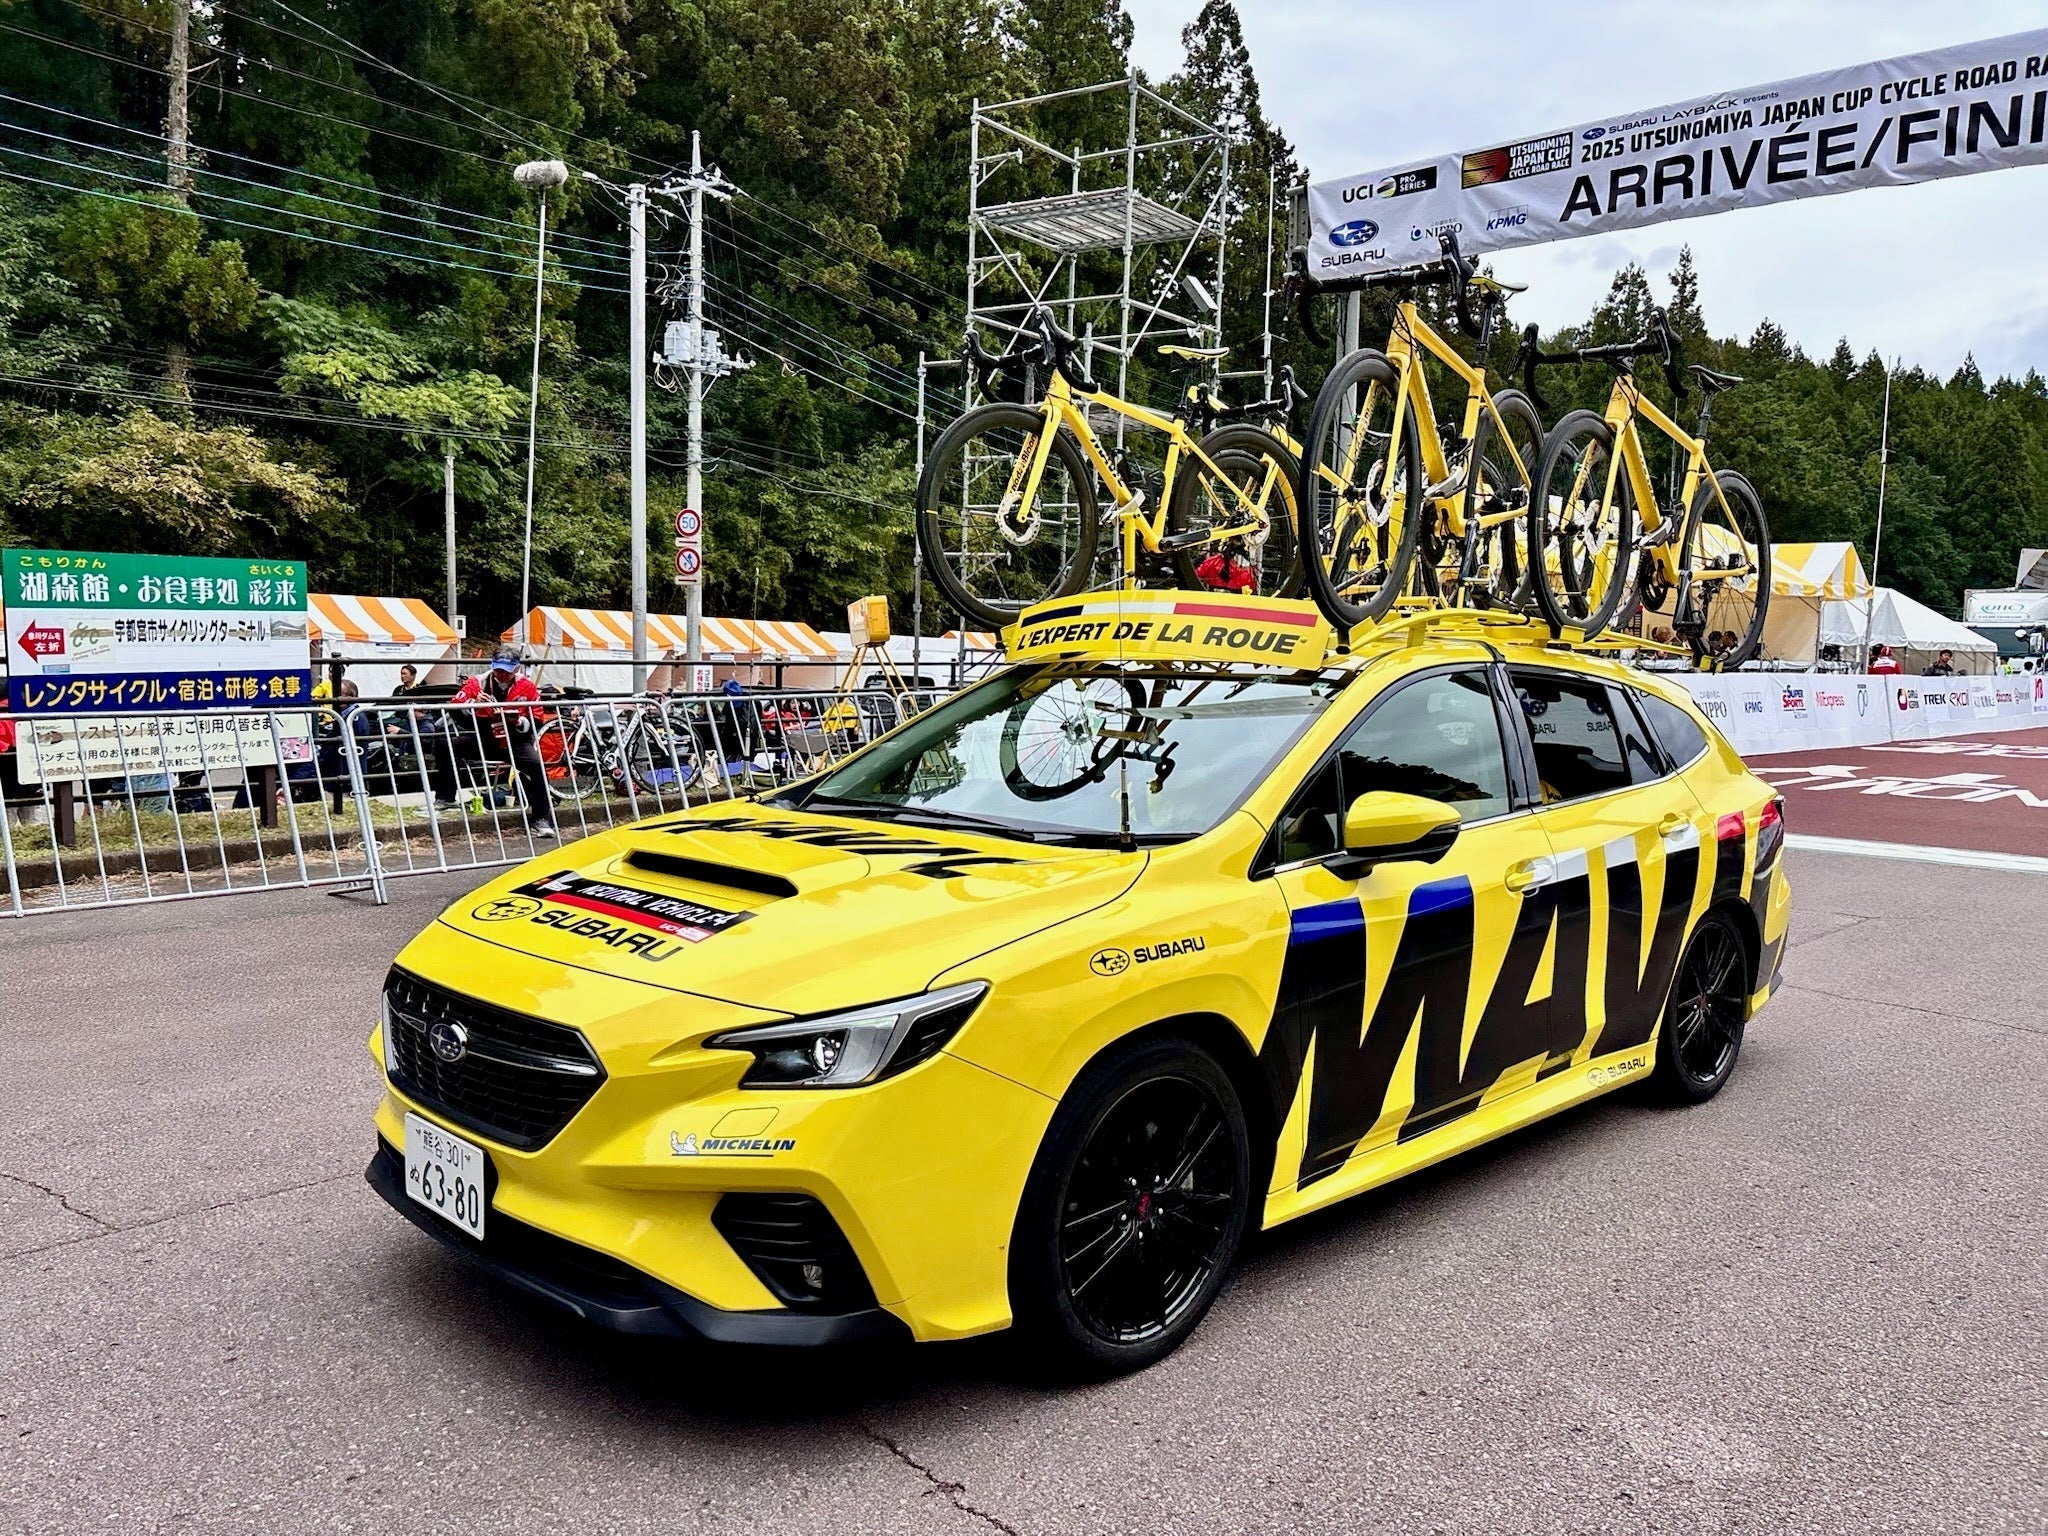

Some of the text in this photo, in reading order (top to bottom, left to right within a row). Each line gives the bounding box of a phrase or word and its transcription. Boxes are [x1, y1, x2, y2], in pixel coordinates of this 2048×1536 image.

[1581, 136, 1625, 163] 2025
[1630, 109, 1752, 153] UTSUNOMIYA
[1759, 96, 1826, 127] JAPAN
[1832, 87, 1873, 113] CUP
[1879, 74, 1947, 105] CYCLE
[1954, 60, 2018, 92] ROAD
[1608, 91, 1779, 134] SUBARU LAYBACK presents
[1510, 134, 1571, 158] UTSUNOMIYA
[1509, 158, 1570, 178] CYCLE ROAD RACE
[1510, 146, 1571, 170] JAPAN CUP
[1399, 174, 1416, 185] PRO
[1400, 179, 1427, 192] SERIES
[1342, 184, 1373, 204] UCI
[1486, 212, 1528, 232] KPMG
[1321, 247, 1386, 268] SUBARU
[681, 516, 696, 530] 50
[20, 556, 106, 568] こもりかん
[249, 564, 295, 576] さいくる
[248, 578, 297, 606] 彩来
[114, 618, 266, 642] 宇都宮市サイクリングターミナル
[1017, 621, 1300, 654] L'EXPERT DE LA ROUE
[1744, 701, 1763, 714] KPMG
[1782, 694, 1804, 709] SPORTS
[1923, 693, 1947, 706] TREK
[576, 883, 653, 906] NEUTRAL
[530, 909, 684, 962] SUBARU
[1134, 936, 1205, 963] SUBARU
[1607, 1055, 1646, 1078] SUBARU
[423, 1130, 464, 1171] 熊谷 301
[701, 1139, 796, 1151] MICHELIN
[422, 1160, 479, 1229] 63-80
